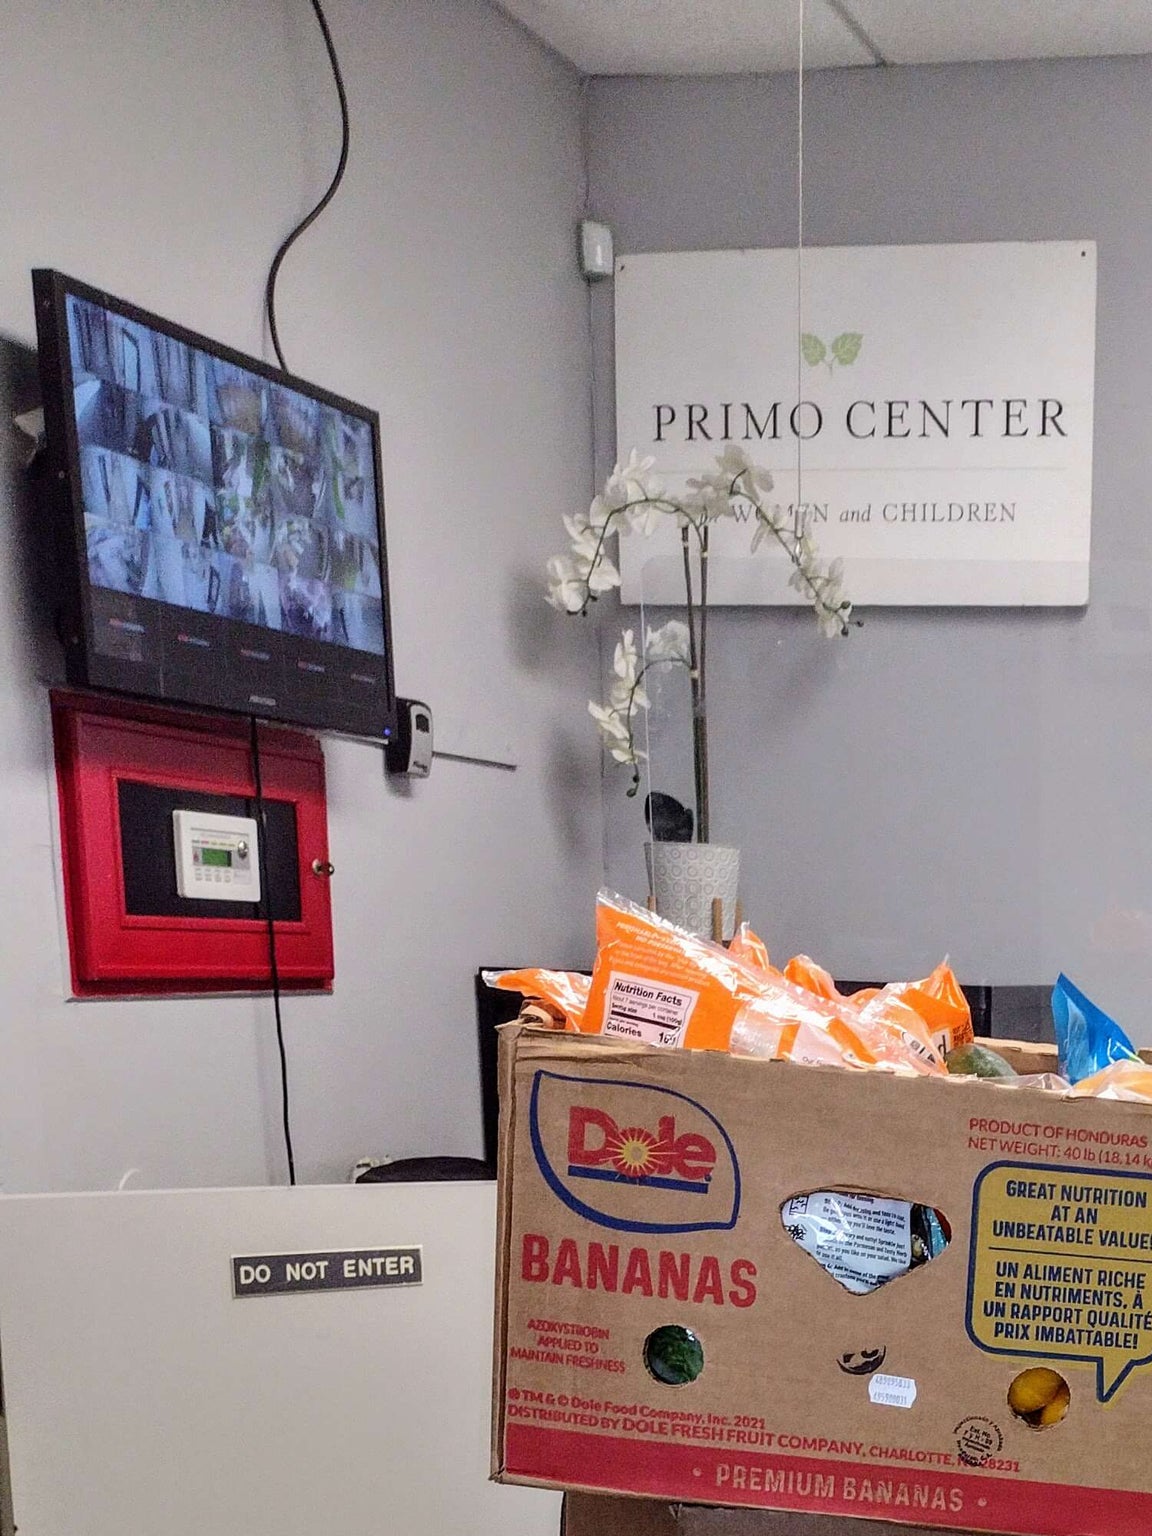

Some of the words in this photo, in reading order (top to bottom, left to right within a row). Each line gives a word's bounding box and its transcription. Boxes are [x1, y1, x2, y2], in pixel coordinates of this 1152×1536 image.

[652, 401, 823, 442] PRIMO
[845, 398, 1070, 440] CENTER
[839, 503, 872, 523] and
[882, 501, 1018, 523] CHILDREN
[614, 981, 654, 999] Nutrition
[656, 992, 683, 1007] Facts
[606, 1022, 642, 1037] Calories
[567, 1106, 717, 1181] Dole
[969, 1118, 1041, 1140] PRODUCT
[1043, 1126, 1064, 1140] OF
[1066, 1128, 1148, 1149] HONDURAS
[968, 1136, 997, 1153] NET
[999, 1139, 1062, 1158] WEIGHT:
[1064, 1144, 1082, 1160] 40
[1083, 1146, 1096, 1162] lb
[1006, 1179, 1058, 1203] GREAT
[1061, 1183, 1148, 1209] NUTRITION
[1051, 1205, 1071, 1223] AT
[1074, 1207, 1098, 1225] AN
[993, 1221, 1094, 1245] UNBEATABLE
[240, 1263, 272, 1286] DO
[286, 1260, 329, 1283] NOT
[342, 1256, 415, 1279] ENTER
[520, 1233, 758, 1309] BANANAS
[996, 1261, 1019, 1279] UN
[1023, 1264, 1094, 1288] ALIMENT
[1098, 1271, 1146, 1290] RICHE
[995, 1281, 1016, 1299] EN
[1020, 1284, 1128, 1309] NUTRIMENTS,
[1132, 1290, 1144, 1309] À
[983, 1300, 1006, 1318] UN
[1010, 1304, 1082, 1324] RAPPORT
[1087, 1309, 1152, 1330] QUALITÉ
[537, 1334, 580, 1354] APPLIED
[583, 1340, 599, 1354] TO
[994, 1323, 1030, 1340] PRIX
[1035, 1326, 1138, 1350] IMBATTABLE!
[510, 1347, 563, 1369] MAINTAIN
[565, 1354, 626, 1375] FRESHNESS
[521, 1389, 543, 1405] TM
[570, 1395, 602, 1413] Dole
[604, 1400, 638, 1417] Food
[640, 1406, 704, 1427] Company,
[706, 1413, 730, 1427] Inc.
[734, 1416, 766, 1430] 2021
[507, 1404, 598, 1428] DISTRIBUTED
[600, 1416, 621, 1431] BY
[622, 1418, 669, 1436] DOLE
[671, 1422, 723, 1443] FRESH
[726, 1428, 776, 1447] FRUIT
[777, 1432, 867, 1458] COMPANY,
[870, 1445, 954, 1467] CHARLOTTE,
[716, 1463, 834, 1499] PREMIUM
[843, 1477, 965, 1512] BANANAS
